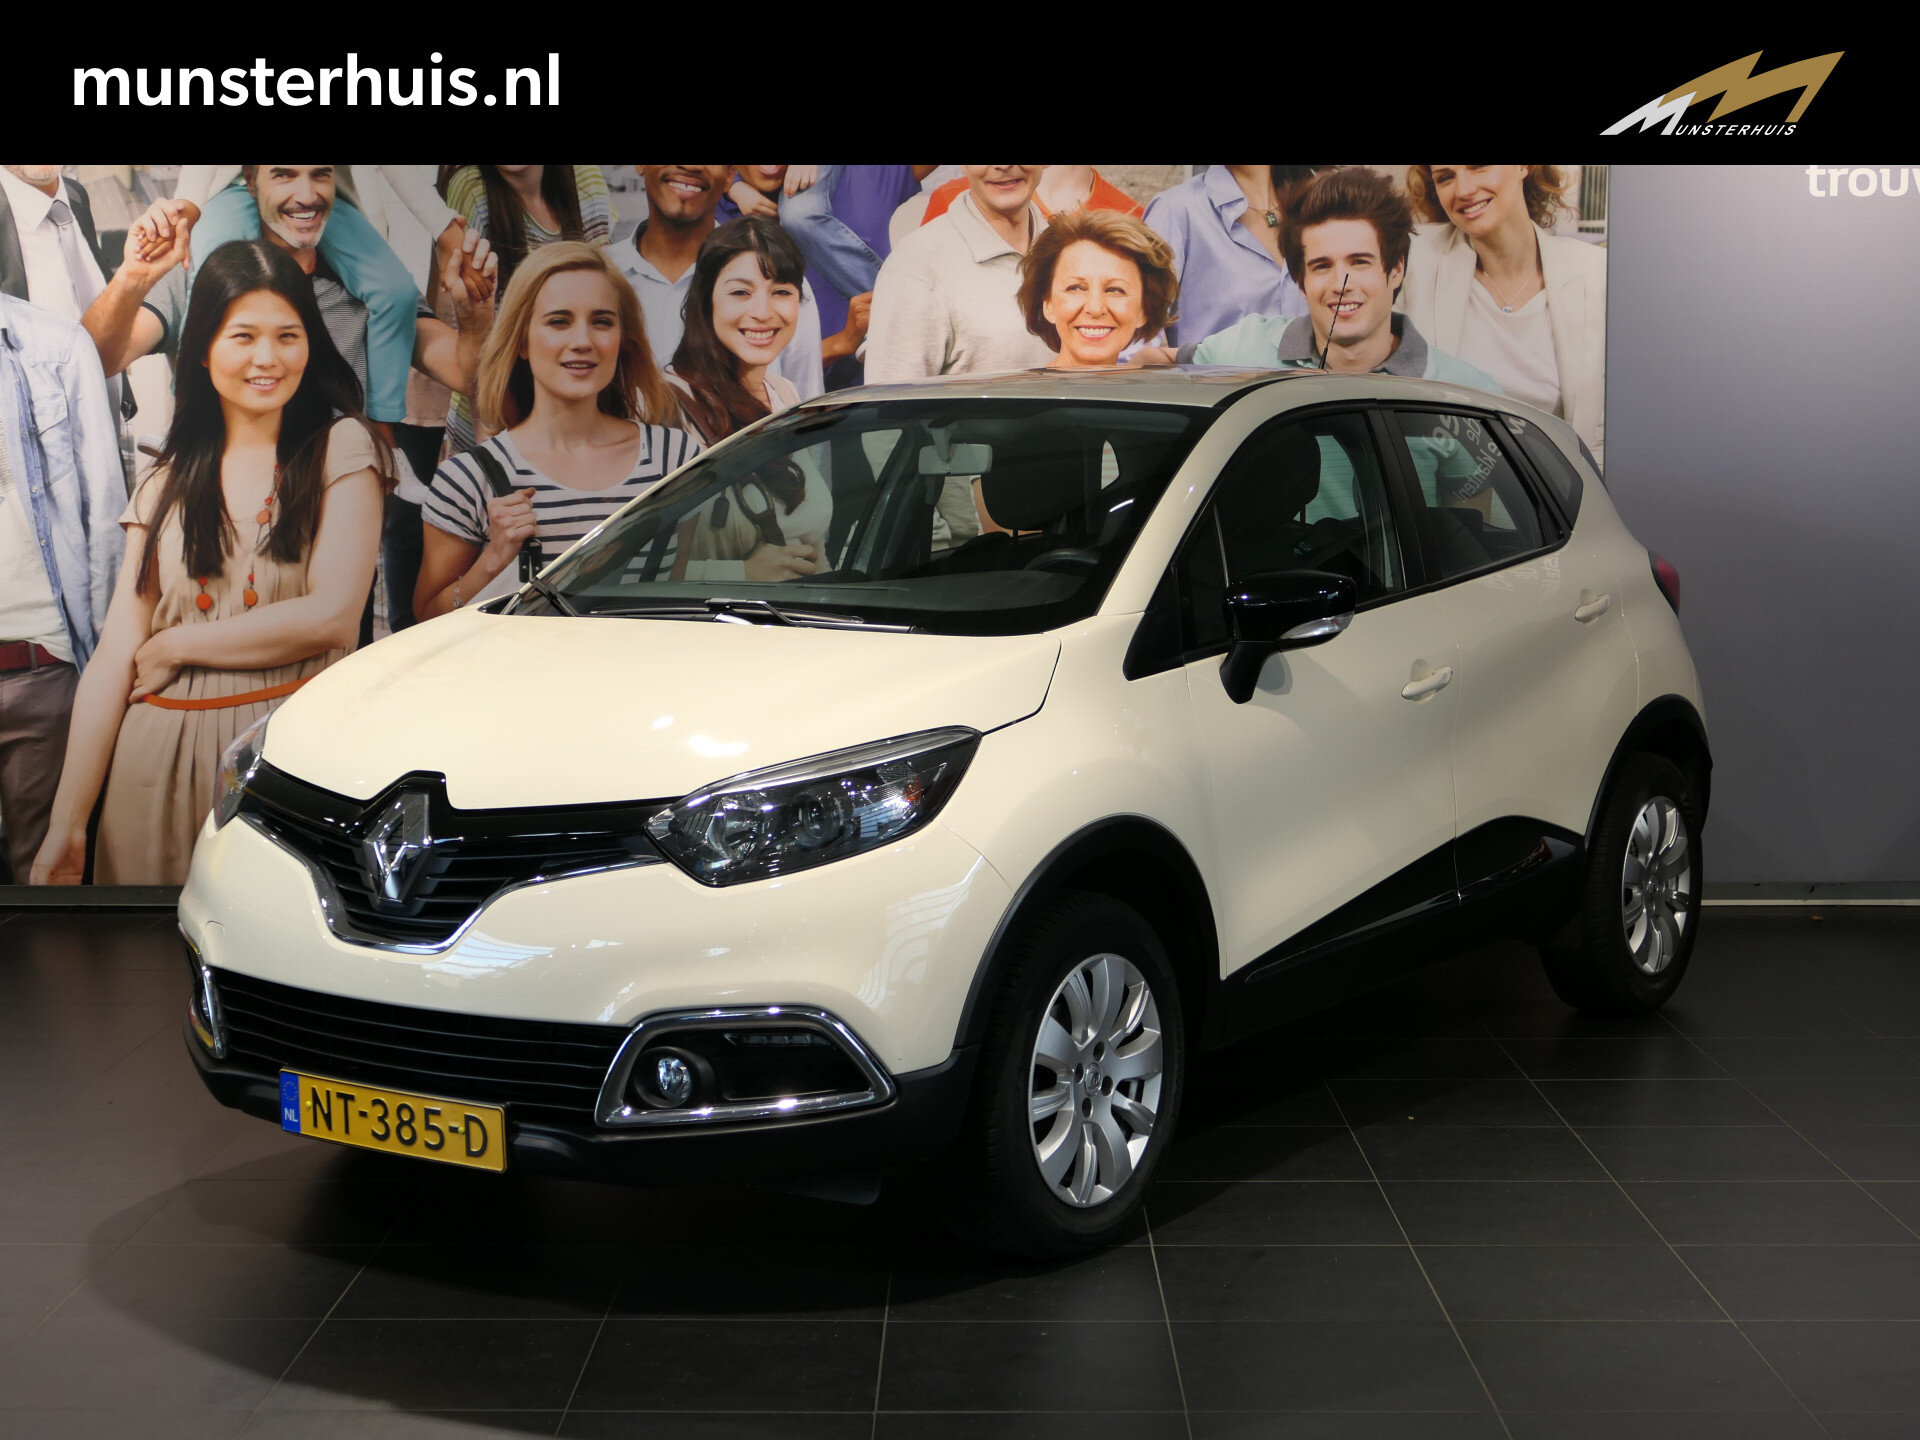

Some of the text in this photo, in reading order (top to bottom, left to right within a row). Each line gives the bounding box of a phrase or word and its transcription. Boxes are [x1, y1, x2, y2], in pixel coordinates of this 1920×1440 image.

[1805, 165, 1920, 197] trou
[284, 1108, 299, 1123] NL
[311, 1086, 489, 1158] NT-385-D
